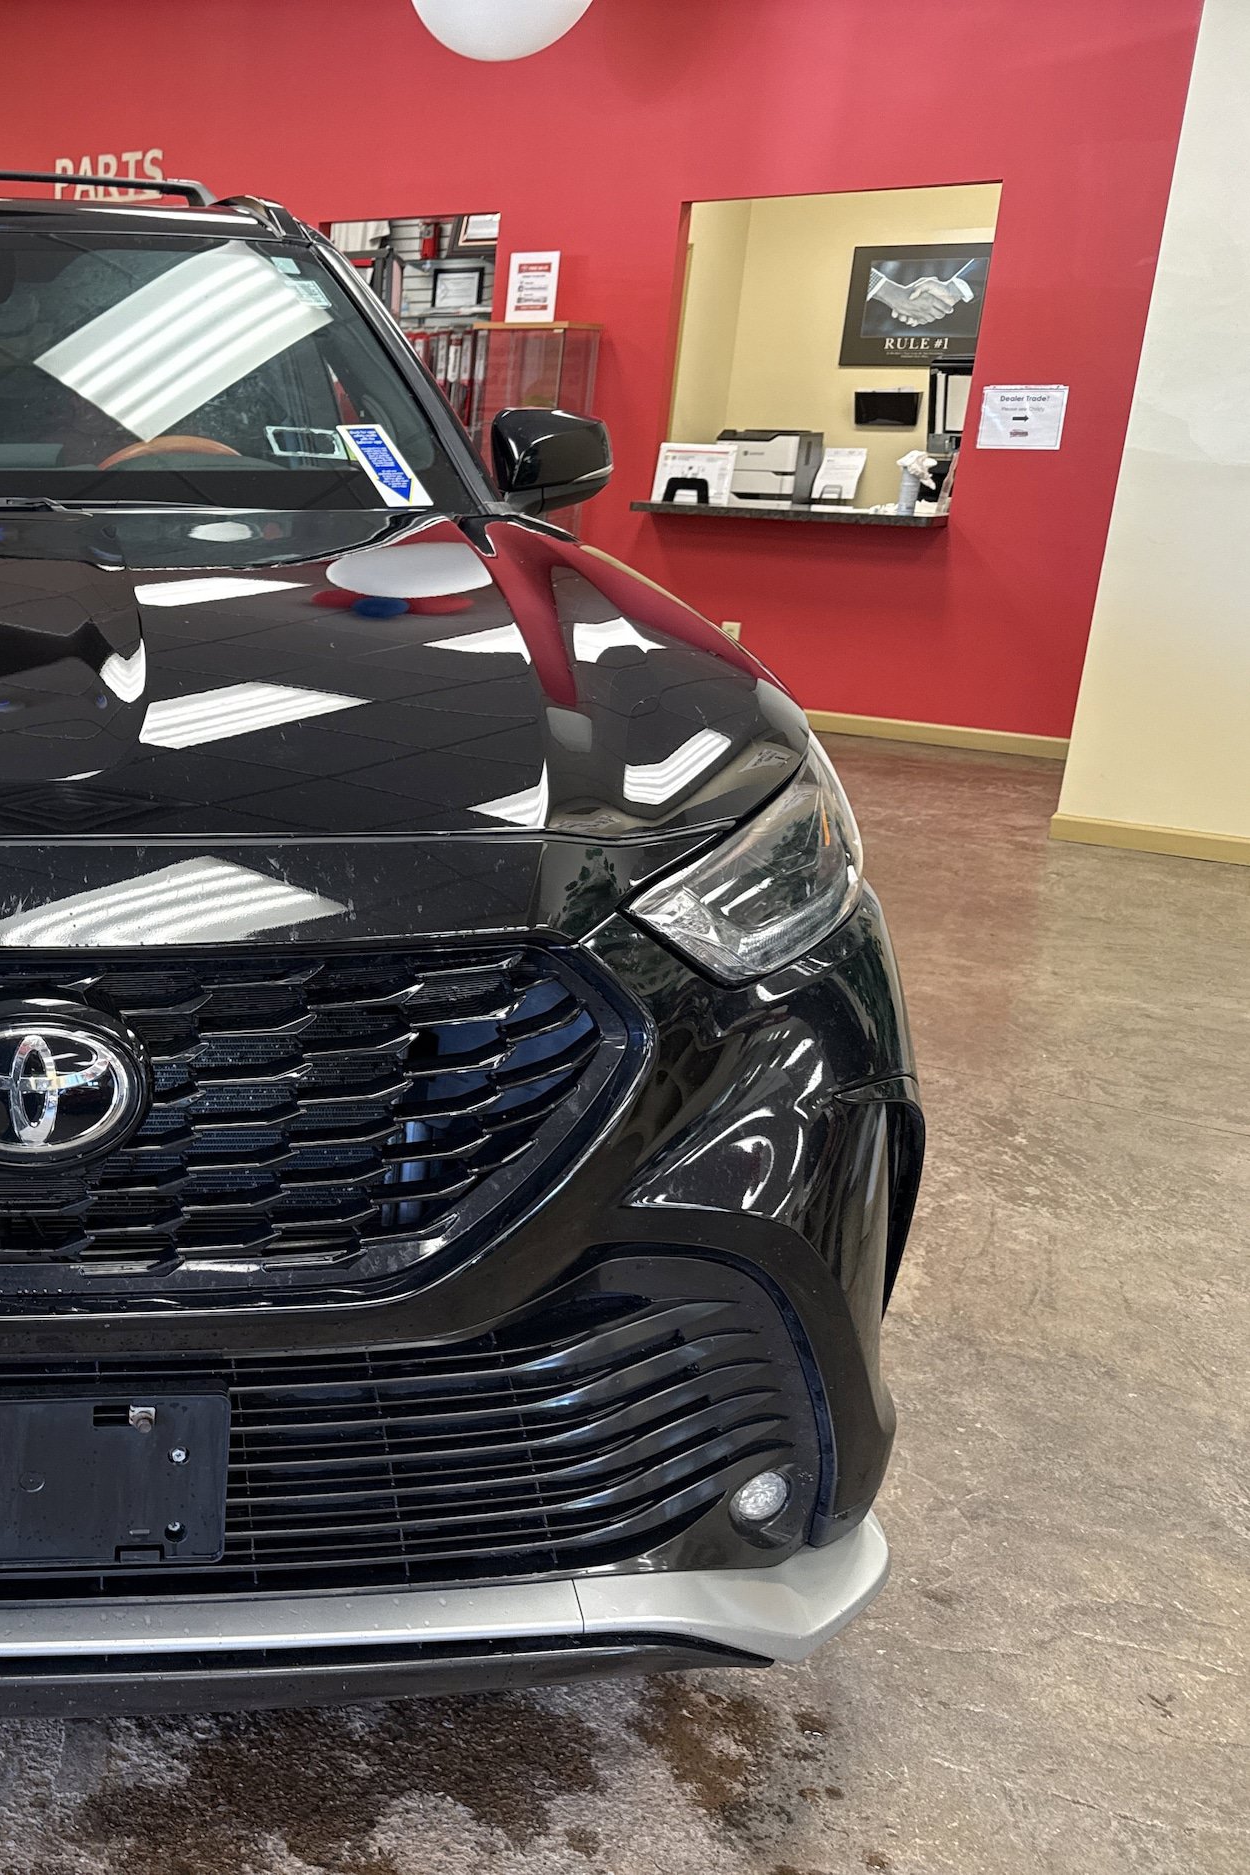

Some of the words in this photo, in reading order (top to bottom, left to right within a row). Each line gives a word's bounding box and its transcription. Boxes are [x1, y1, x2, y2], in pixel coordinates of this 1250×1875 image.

[54, 148, 163, 202] PARTS
[883, 337, 930, 350] RULE
[933, 337, 949, 350] #1
